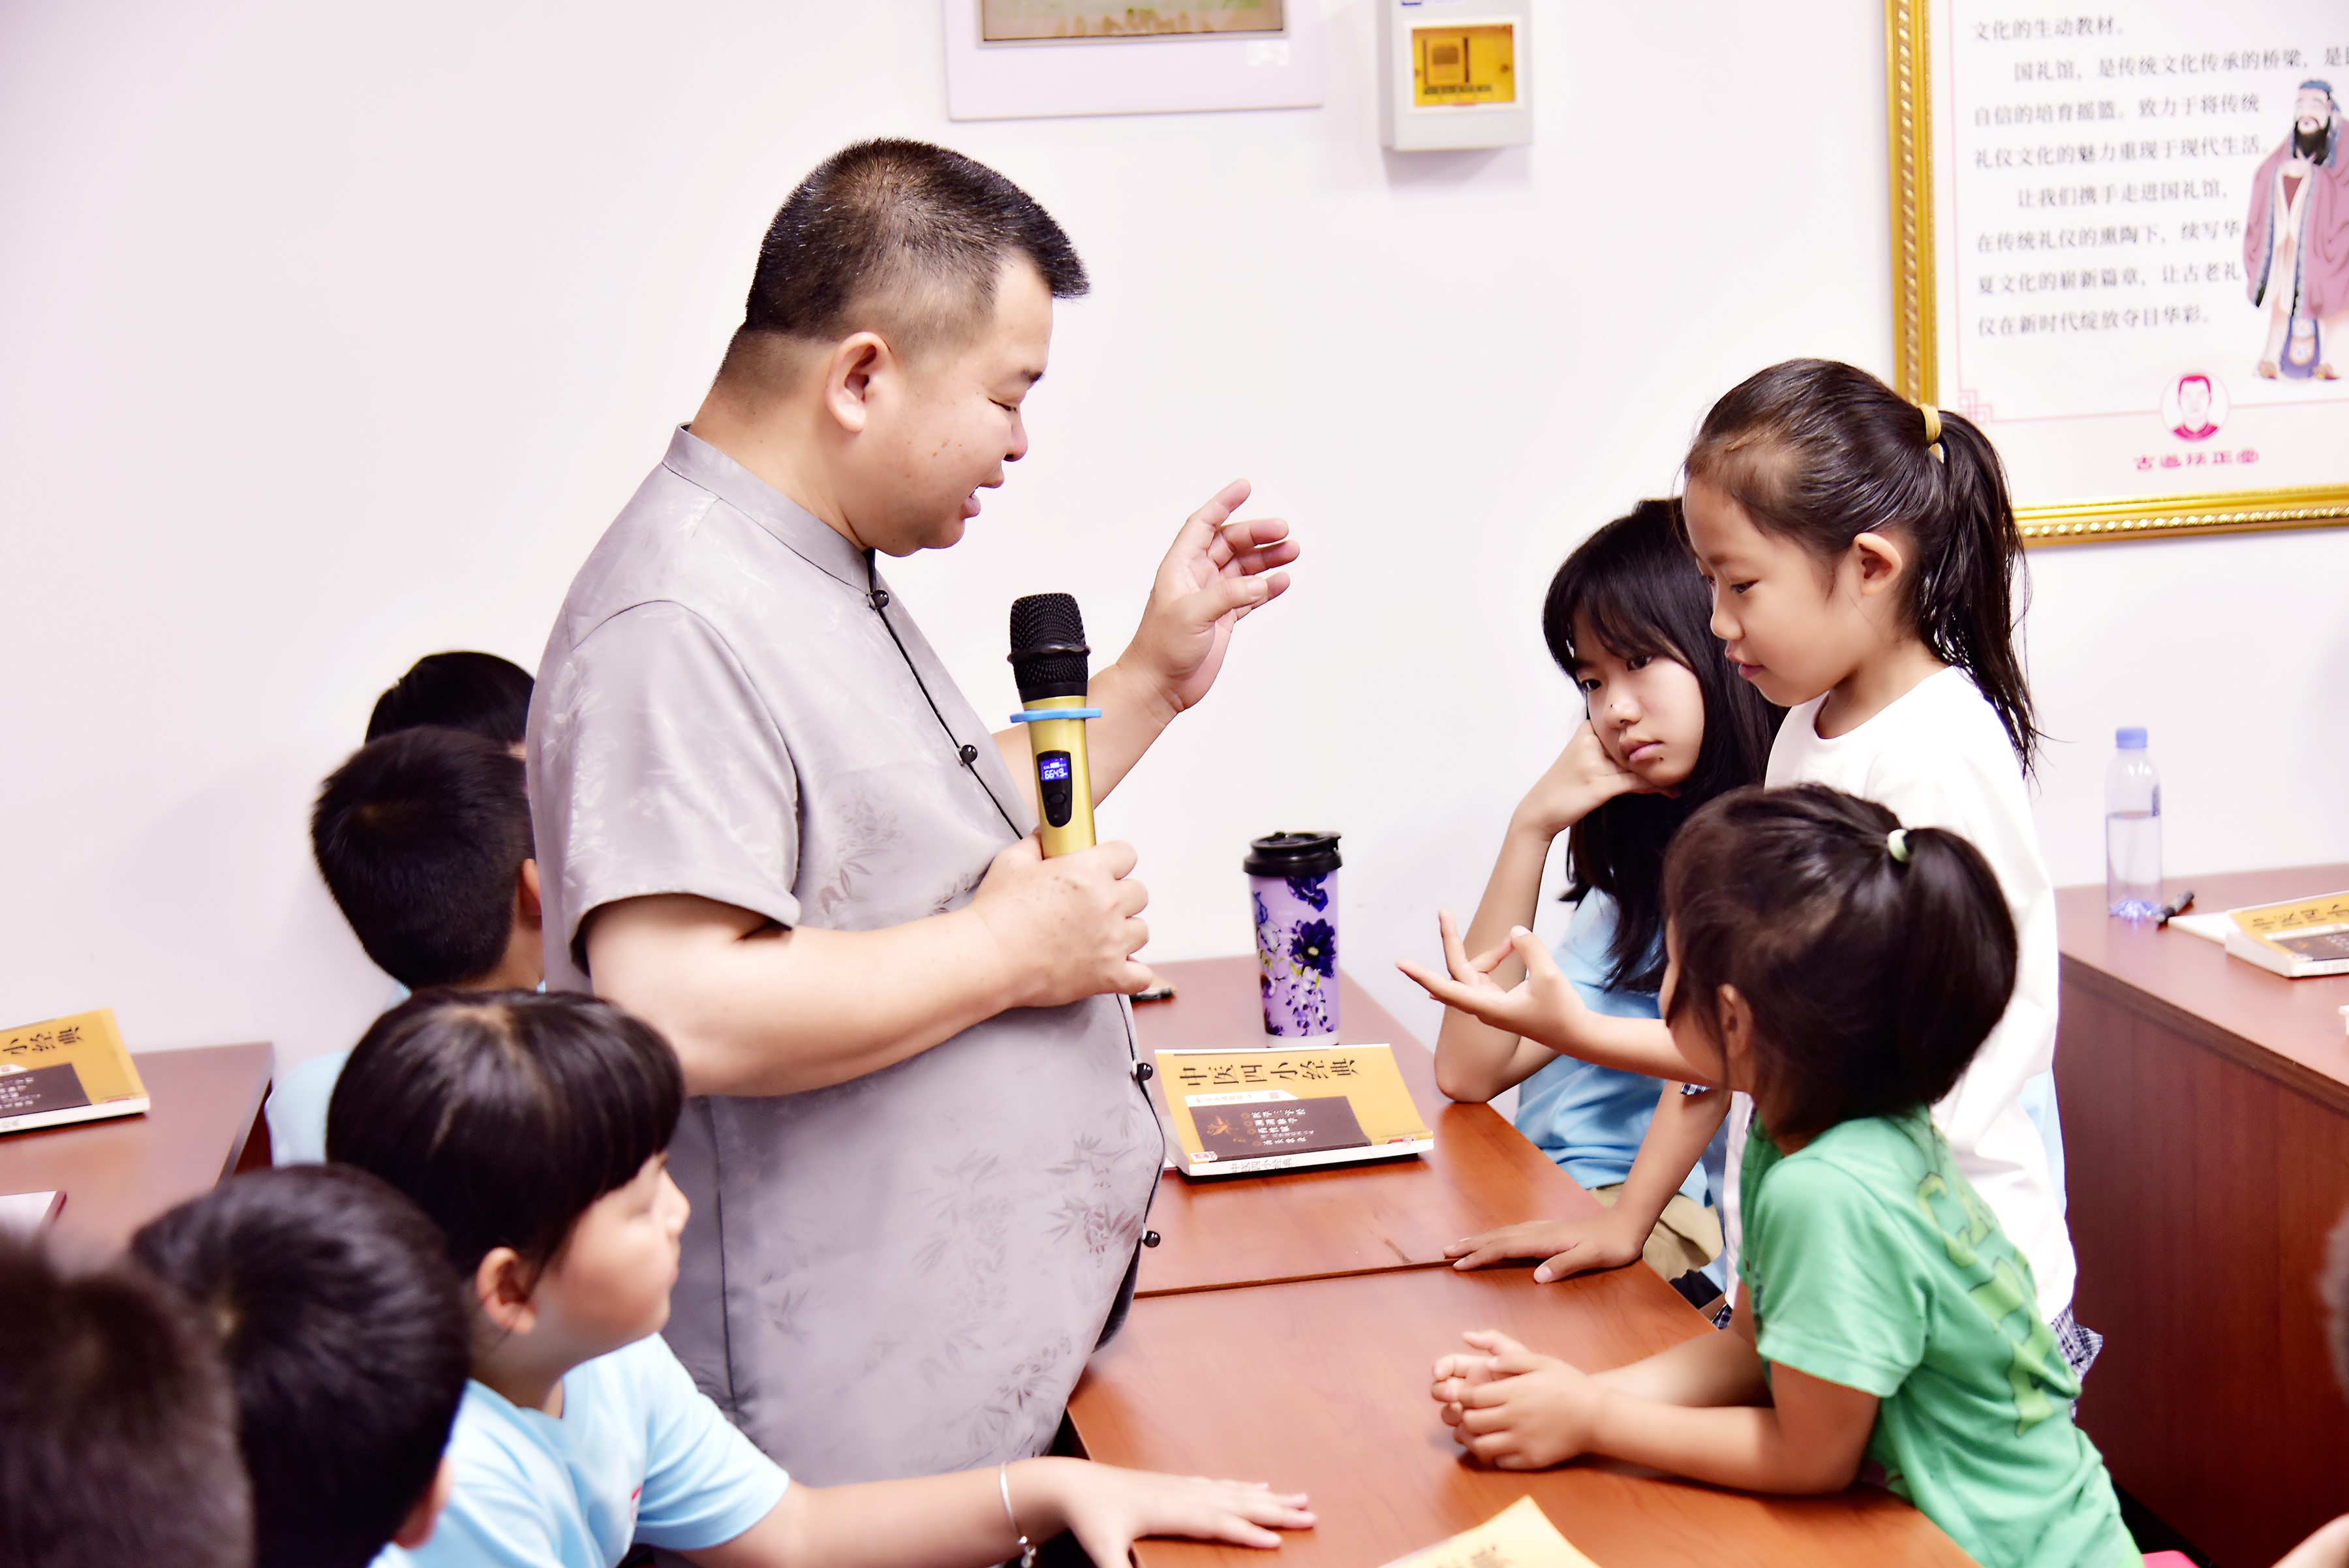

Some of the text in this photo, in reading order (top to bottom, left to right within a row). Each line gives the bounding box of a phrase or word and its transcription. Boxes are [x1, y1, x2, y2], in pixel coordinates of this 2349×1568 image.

[2014, 46, 2349, 82] 国礼馆，是传统文化传承的桥梁，是
[1180, 1058, 1361, 1087] 中医四小经典
